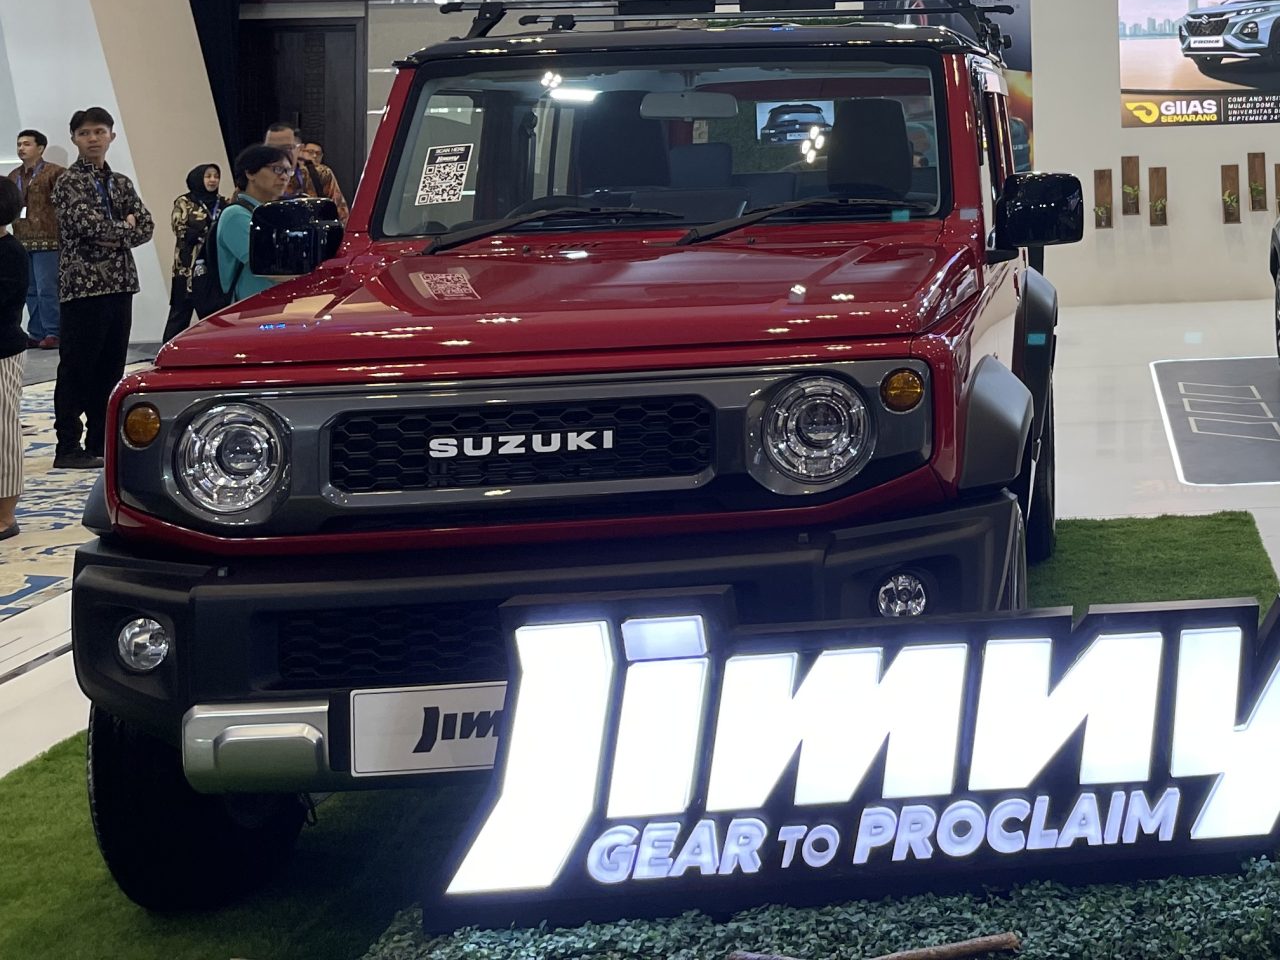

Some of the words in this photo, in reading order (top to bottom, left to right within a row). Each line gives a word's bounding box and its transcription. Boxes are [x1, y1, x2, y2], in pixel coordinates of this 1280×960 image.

[1160, 100, 1217, 115] GIIAS
[1160, 113, 1217, 123] SEMARANG
[428, 429, 613, 458] SUZUKI
[412, 706, 505, 753] Jim
[585, 814, 768, 886] GEAR
[779, 822, 841, 870] TO
[852, 786, 1182, 865] PROCLAIM
